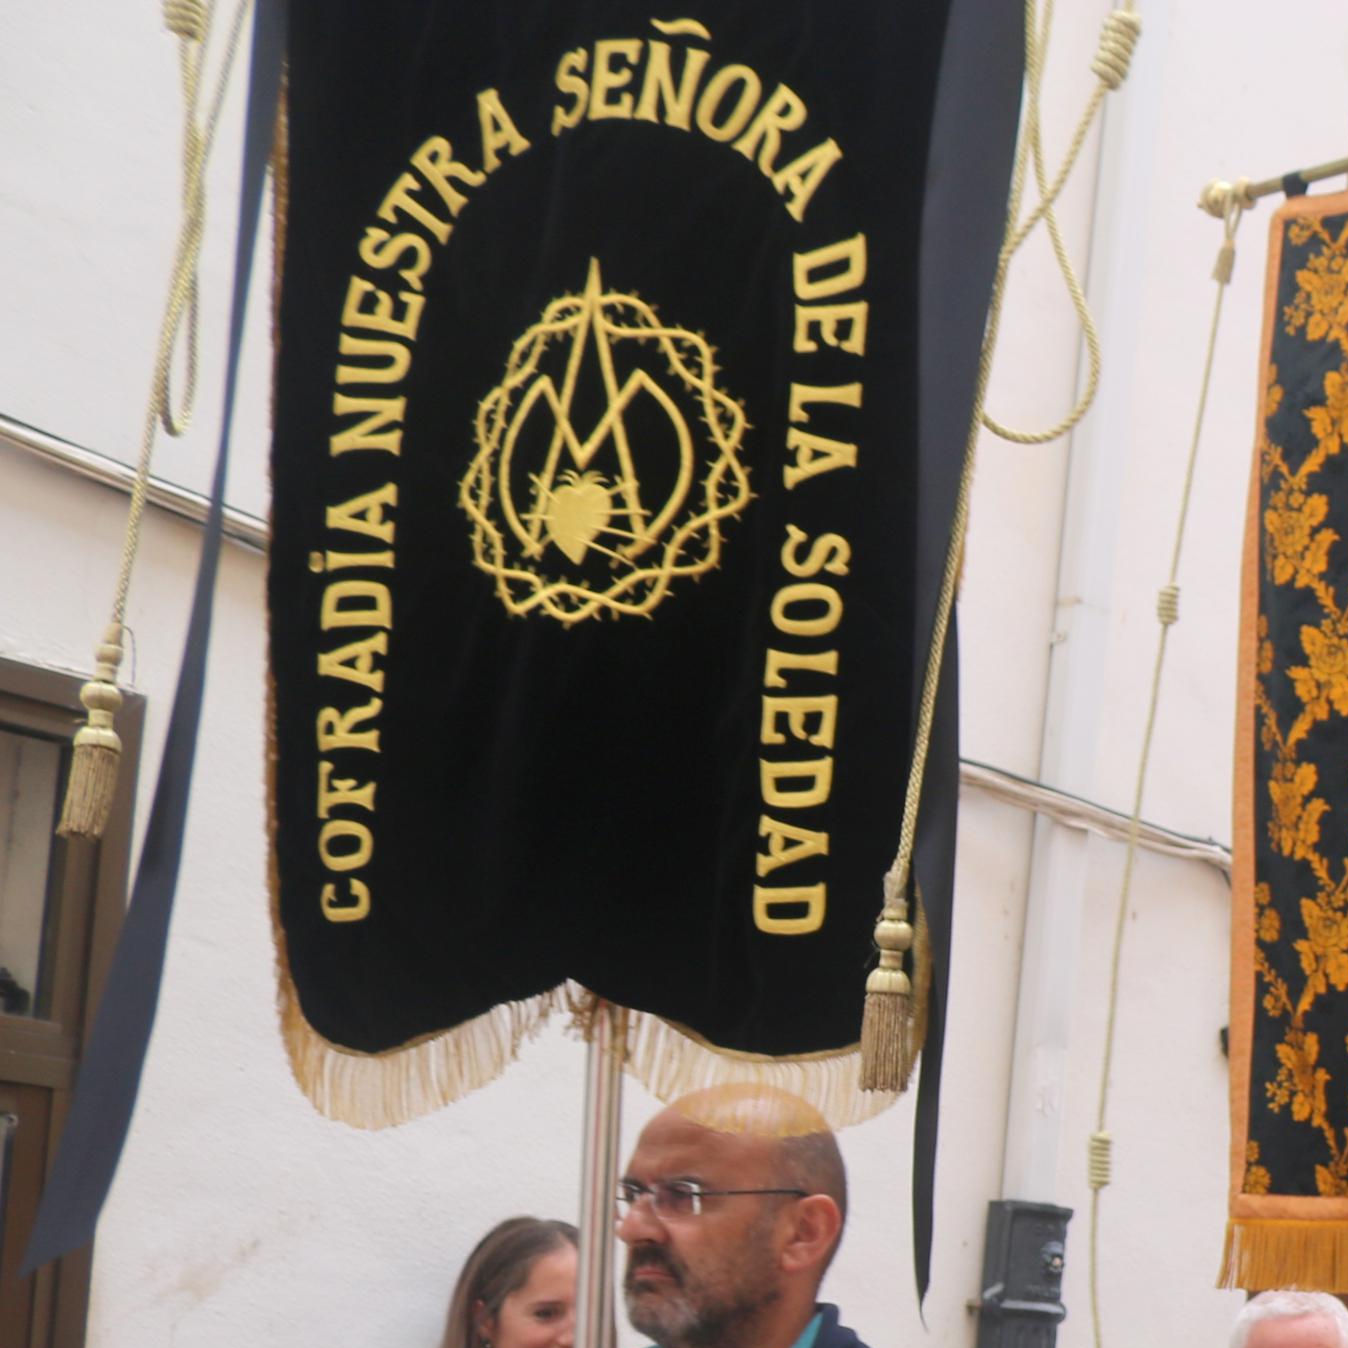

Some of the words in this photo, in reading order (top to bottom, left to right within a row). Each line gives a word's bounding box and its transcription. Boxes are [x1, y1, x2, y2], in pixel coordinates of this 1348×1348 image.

[550, 17, 843, 223] SEÑORA
[329, 88, 532, 456] NUESTRA
[792, 233, 869, 356] DE
[783, 382, 863, 490] LA
[753, 524, 852, 936] SOLEDAD
